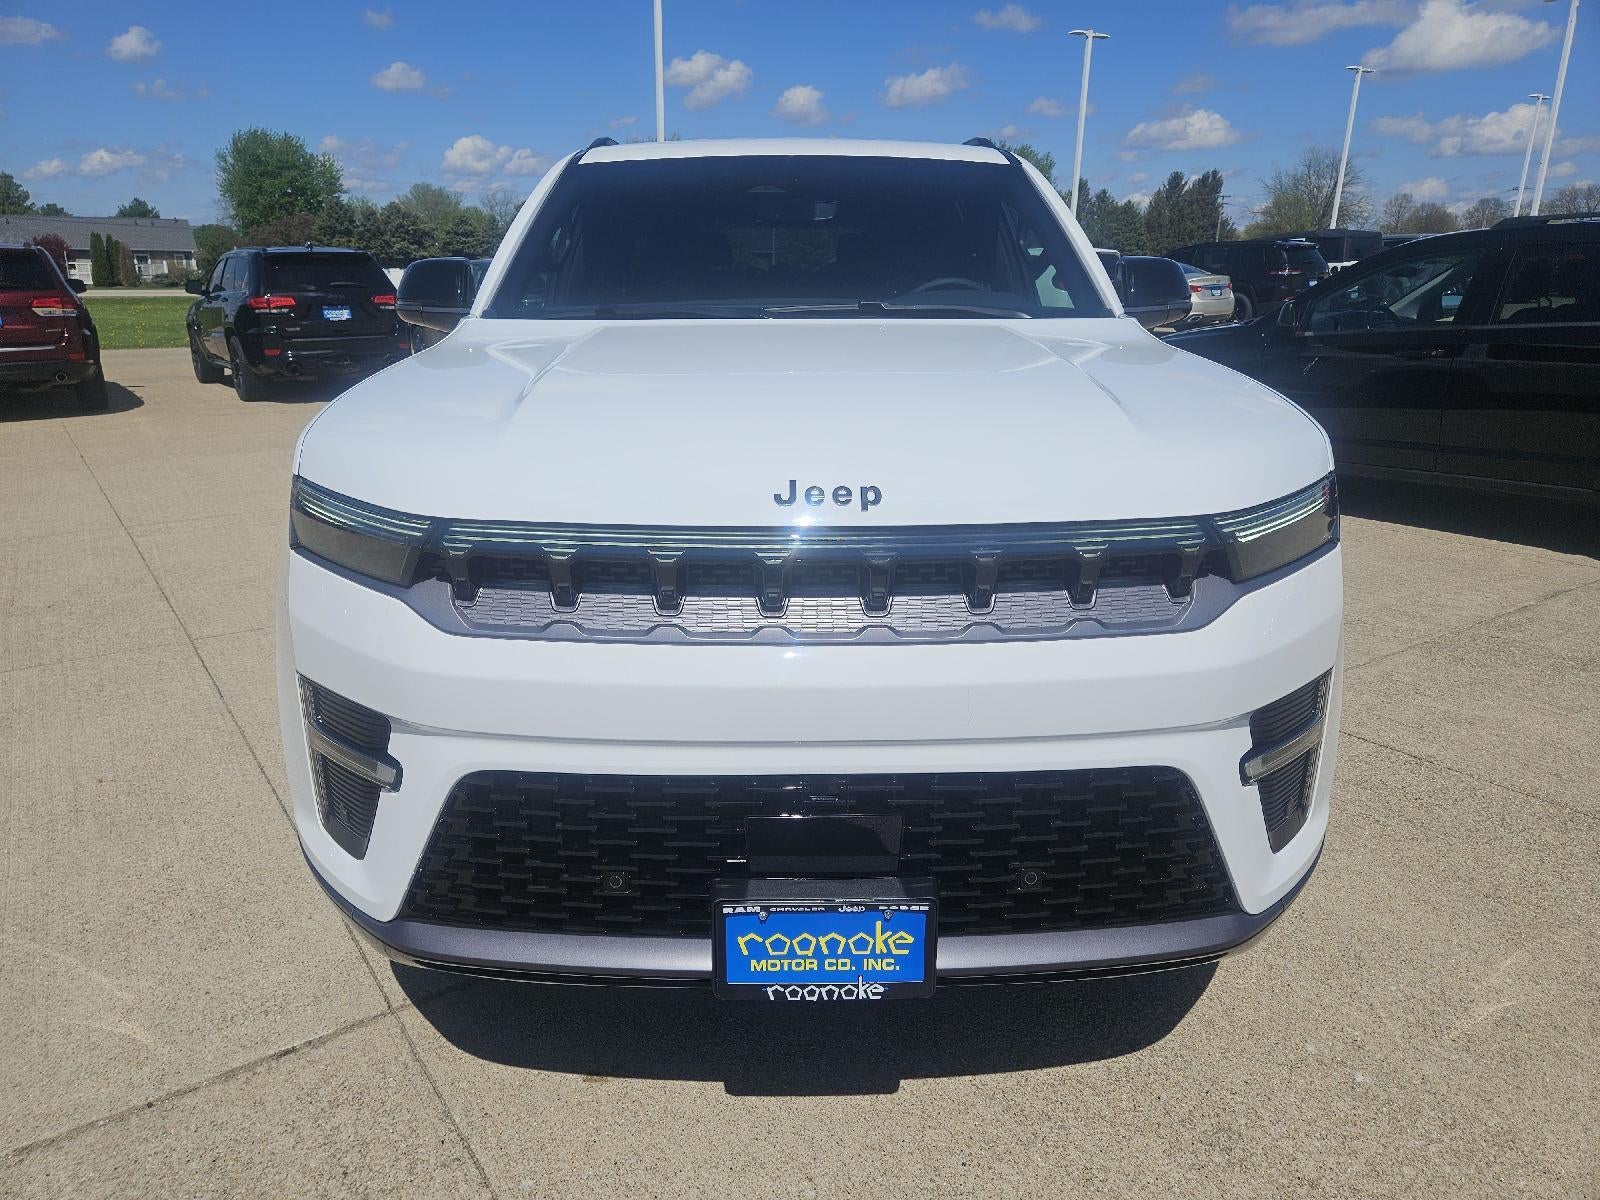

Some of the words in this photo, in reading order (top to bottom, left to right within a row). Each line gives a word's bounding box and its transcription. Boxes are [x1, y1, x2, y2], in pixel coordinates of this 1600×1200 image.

[773, 479, 883, 513] Jeep
[722, 906, 761, 914] RAM
[838, 904, 866, 913] Jeep
[750, 958, 818, 972] MOTOR
[824, 958, 856, 971] CO.
[863, 958, 901, 971] INC.
